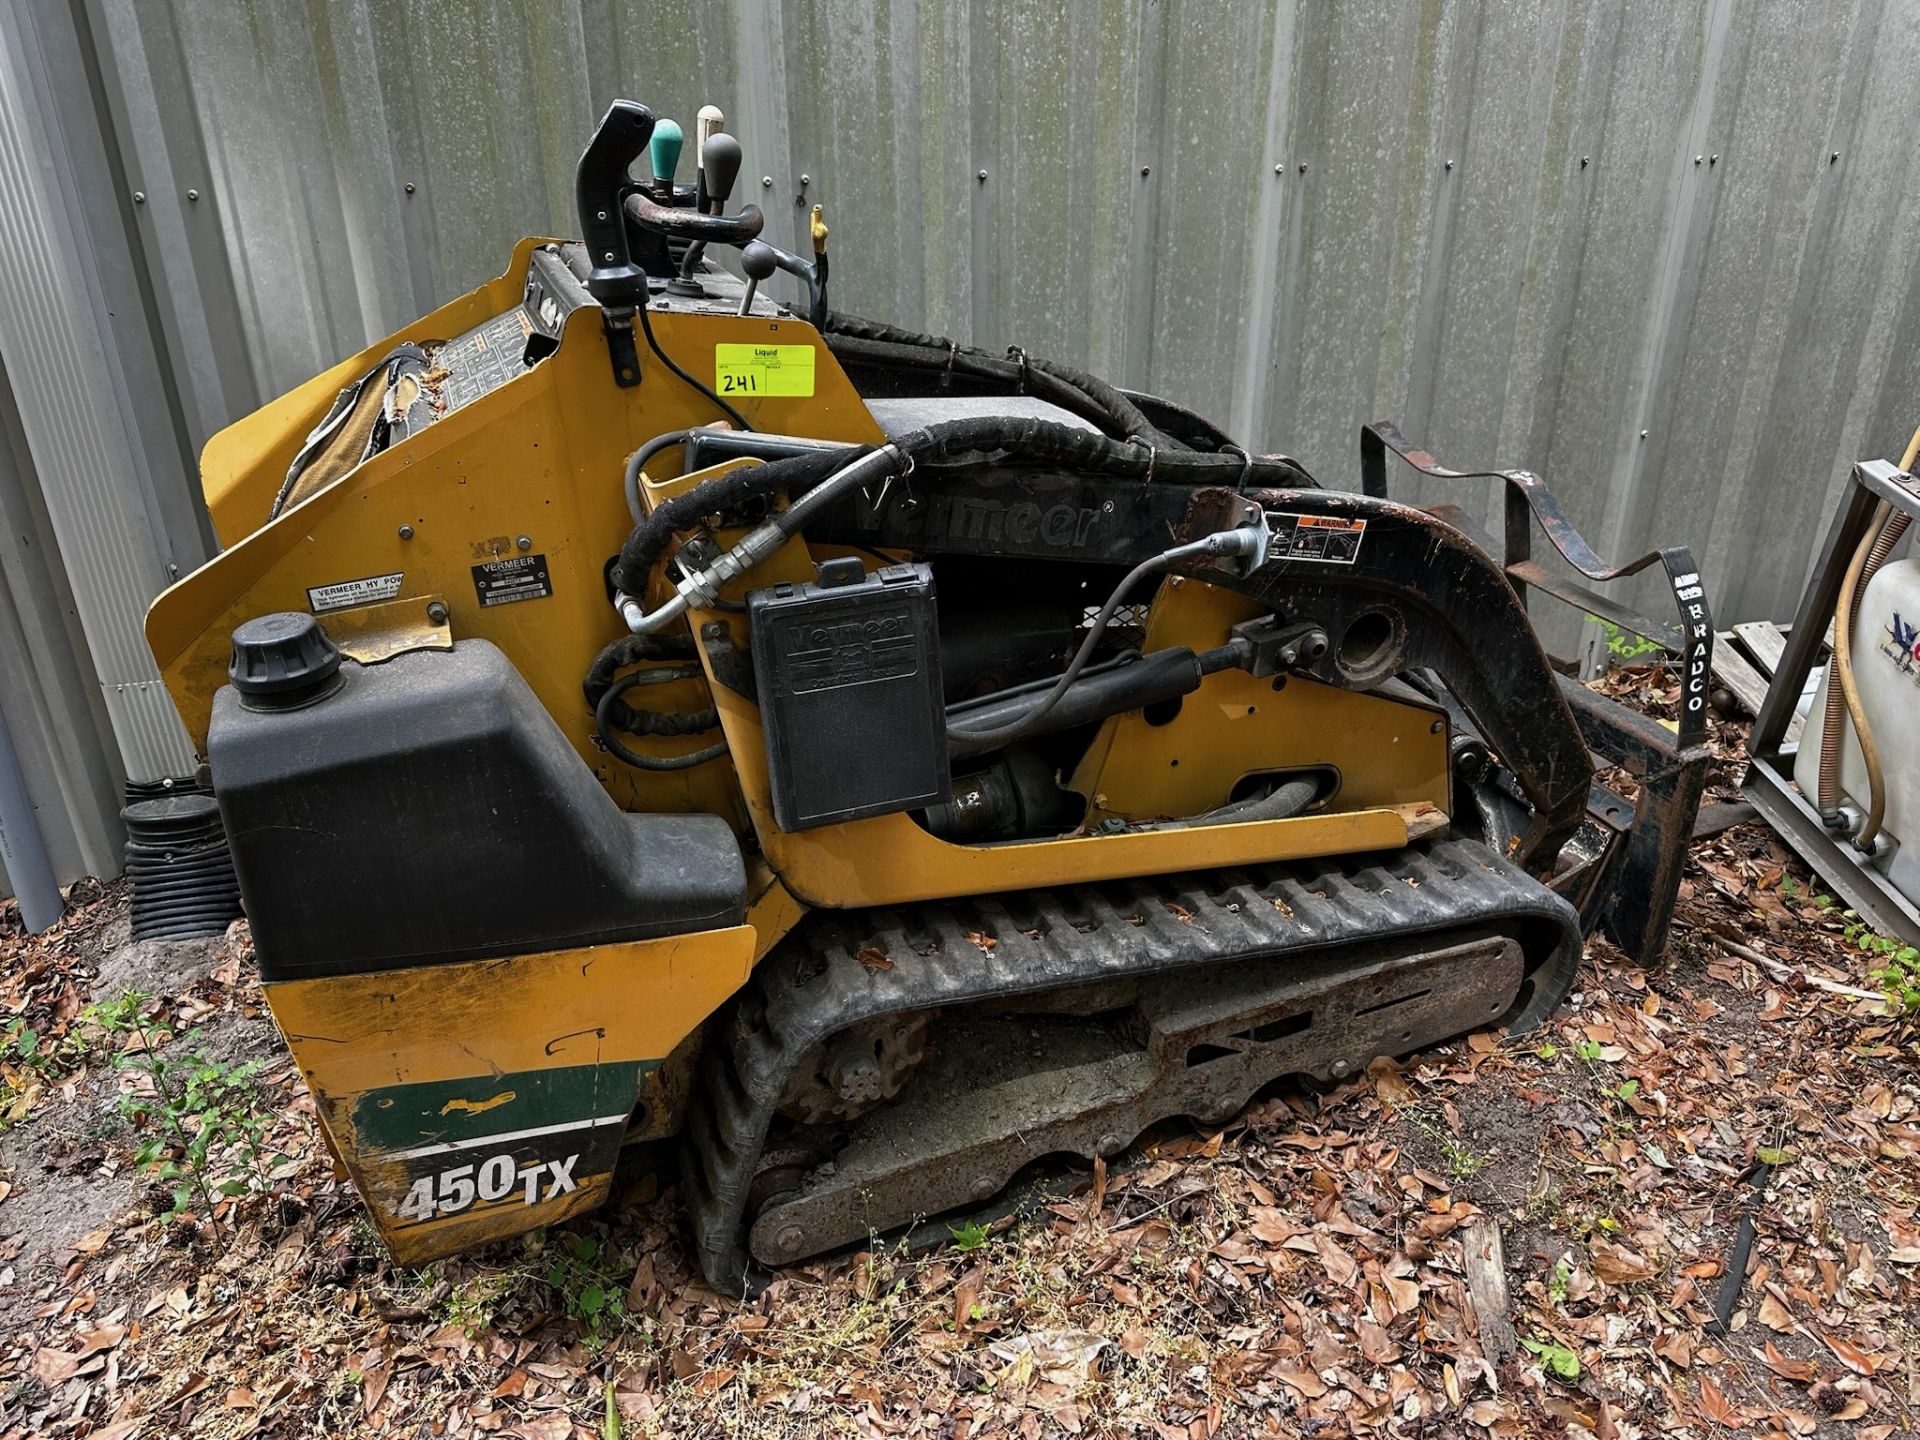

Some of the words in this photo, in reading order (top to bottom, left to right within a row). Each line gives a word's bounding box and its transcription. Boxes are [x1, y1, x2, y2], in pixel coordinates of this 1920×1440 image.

[754, 348, 778, 356] Liquid
[723, 374, 756, 392] 241
[482, 556, 536, 573] VERMEER
[318, 583, 361, 597] VERMEER
[366, 580, 379, 588] HY
[787, 614, 909, 649] Vermeer
[1688, 603, 1707, 711] BRADCO
